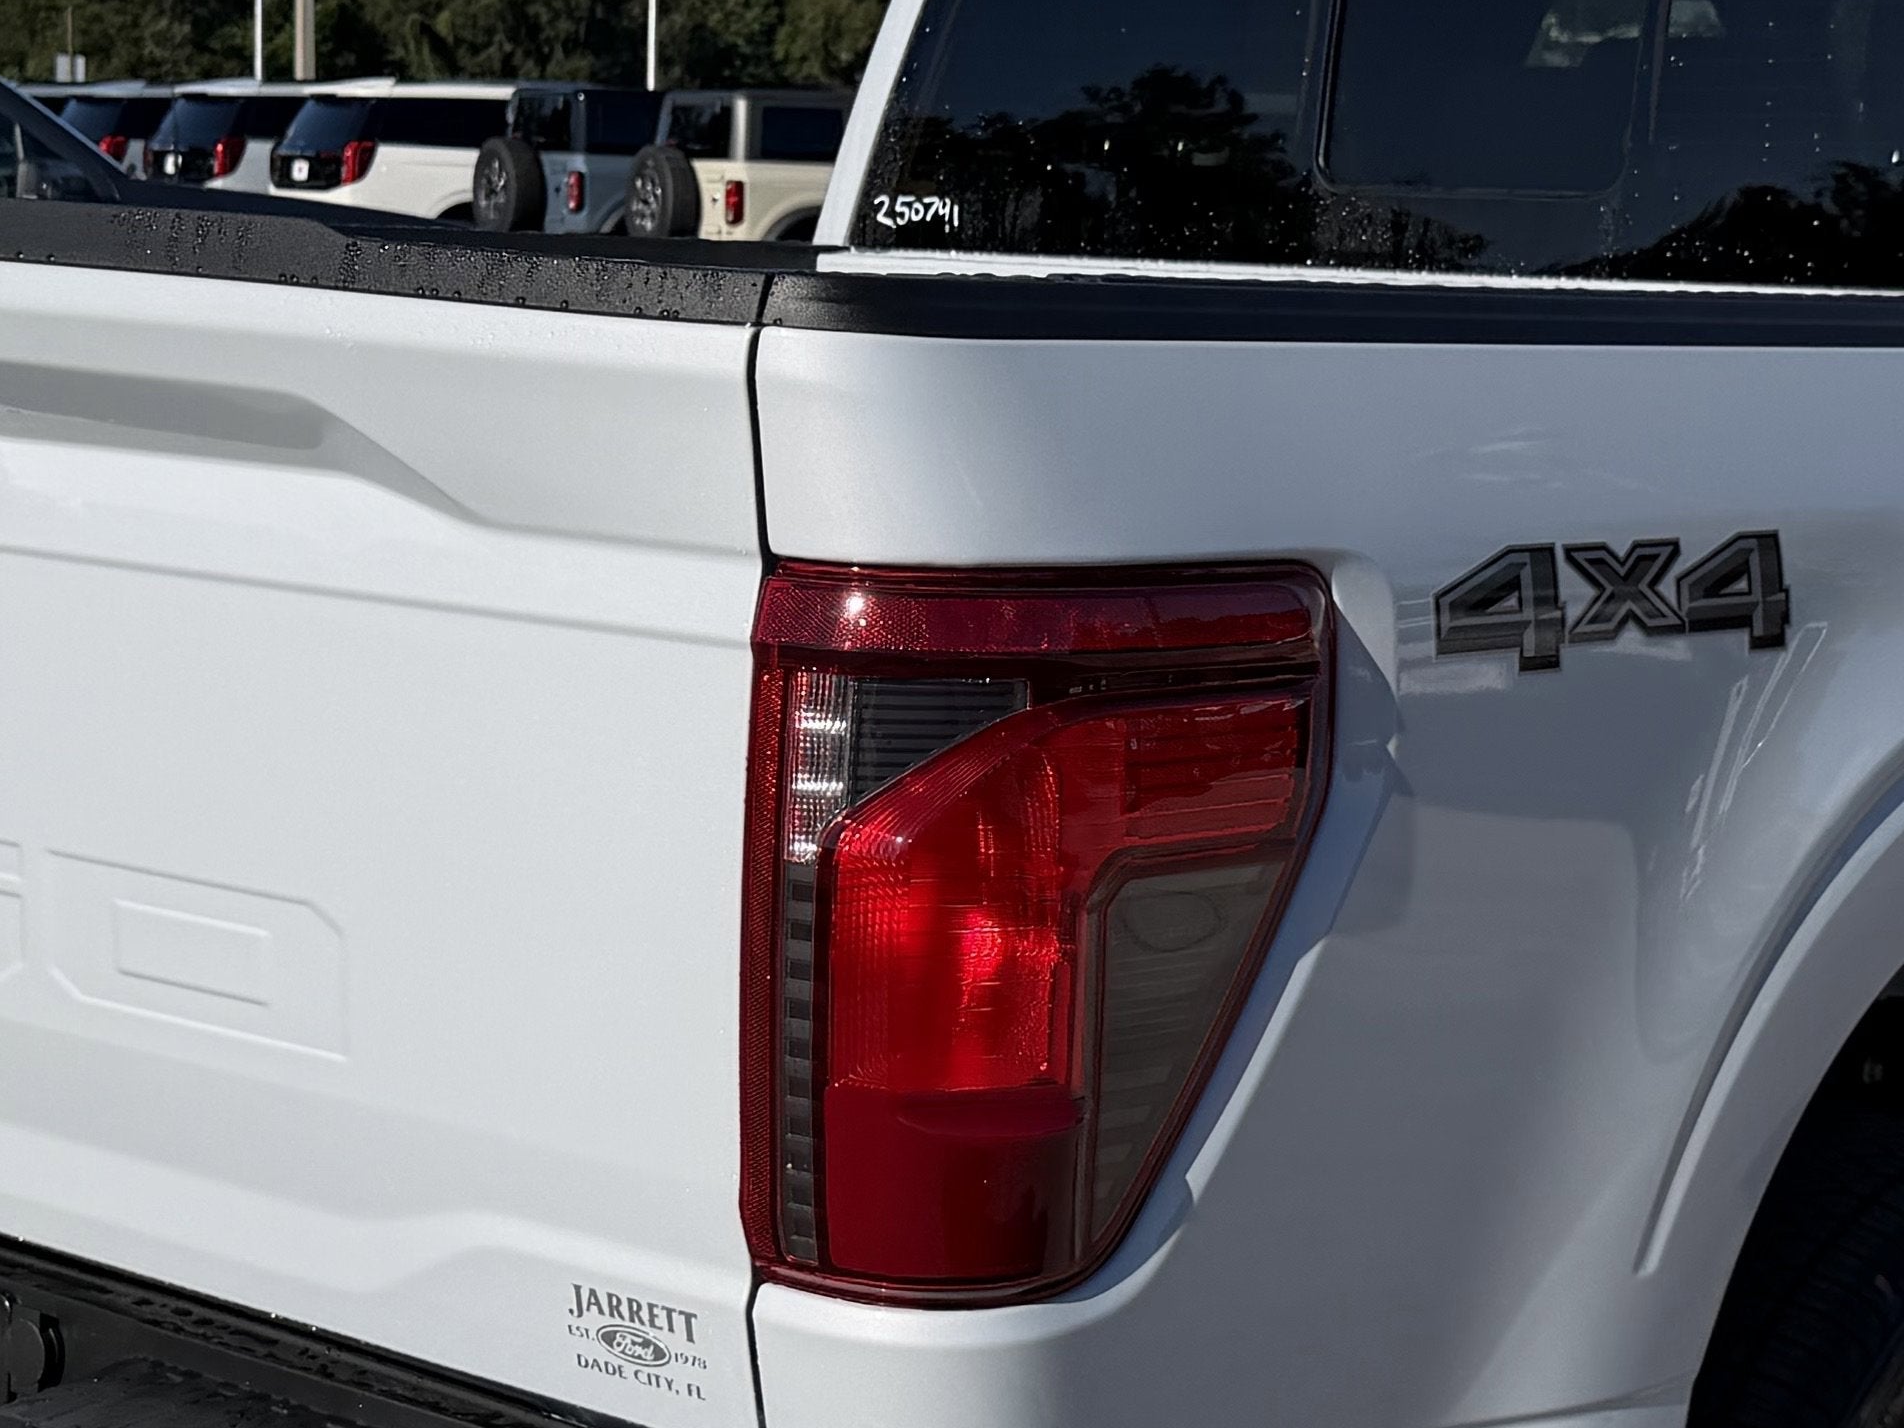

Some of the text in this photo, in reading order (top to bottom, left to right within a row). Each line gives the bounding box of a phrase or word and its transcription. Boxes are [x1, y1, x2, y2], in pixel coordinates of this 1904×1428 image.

[568, 1283, 698, 1344] JARRETT
[568, 1324, 595, 1341] EST.
[613, 1332, 655, 1361] Ford
[577, 1354, 706, 1401] DADE CITY, FL
